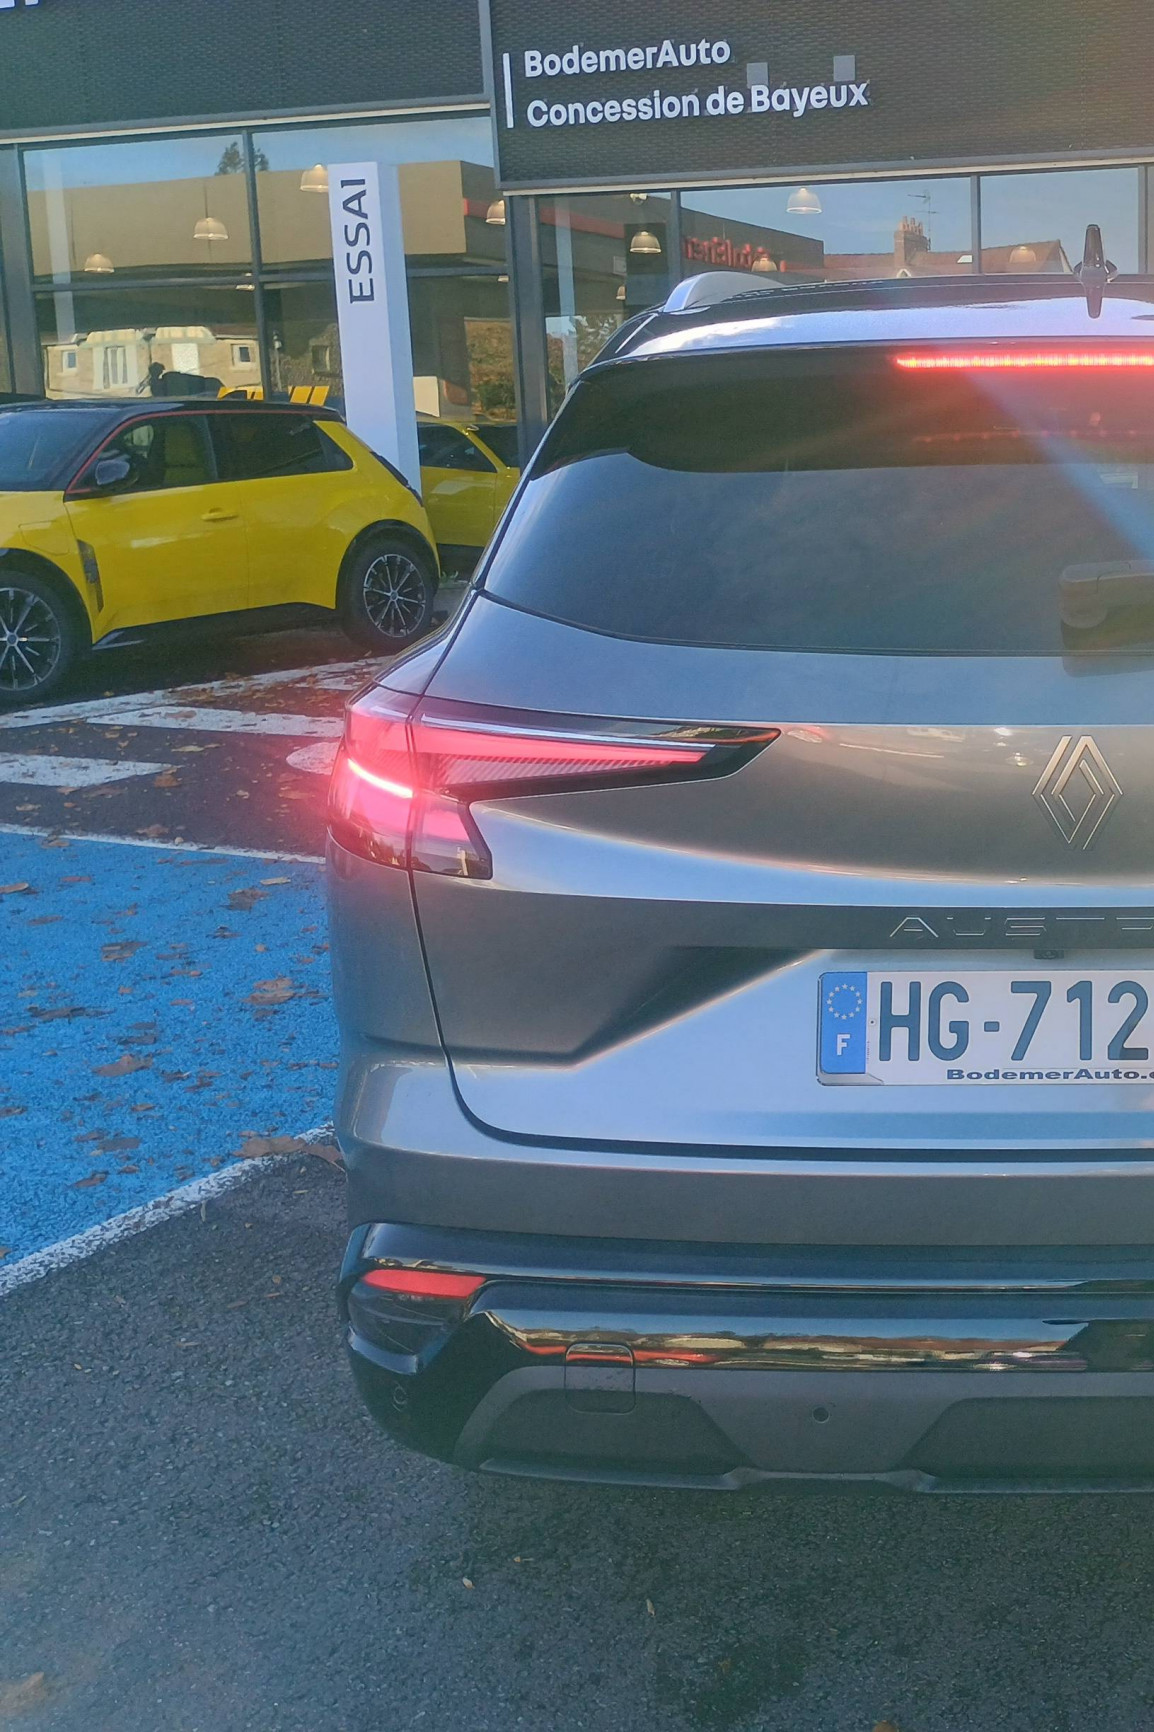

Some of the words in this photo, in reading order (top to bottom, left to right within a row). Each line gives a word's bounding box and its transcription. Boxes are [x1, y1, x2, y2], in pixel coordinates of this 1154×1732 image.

[524, 38, 732, 78] BodemerAuto
[526, 88, 700, 128] Concession
[706, 85, 745, 116] de
[750, 80, 870, 117] Bayeux
[340, 178, 376, 304] ESSAI
[836, 1033, 851, 1056] F
